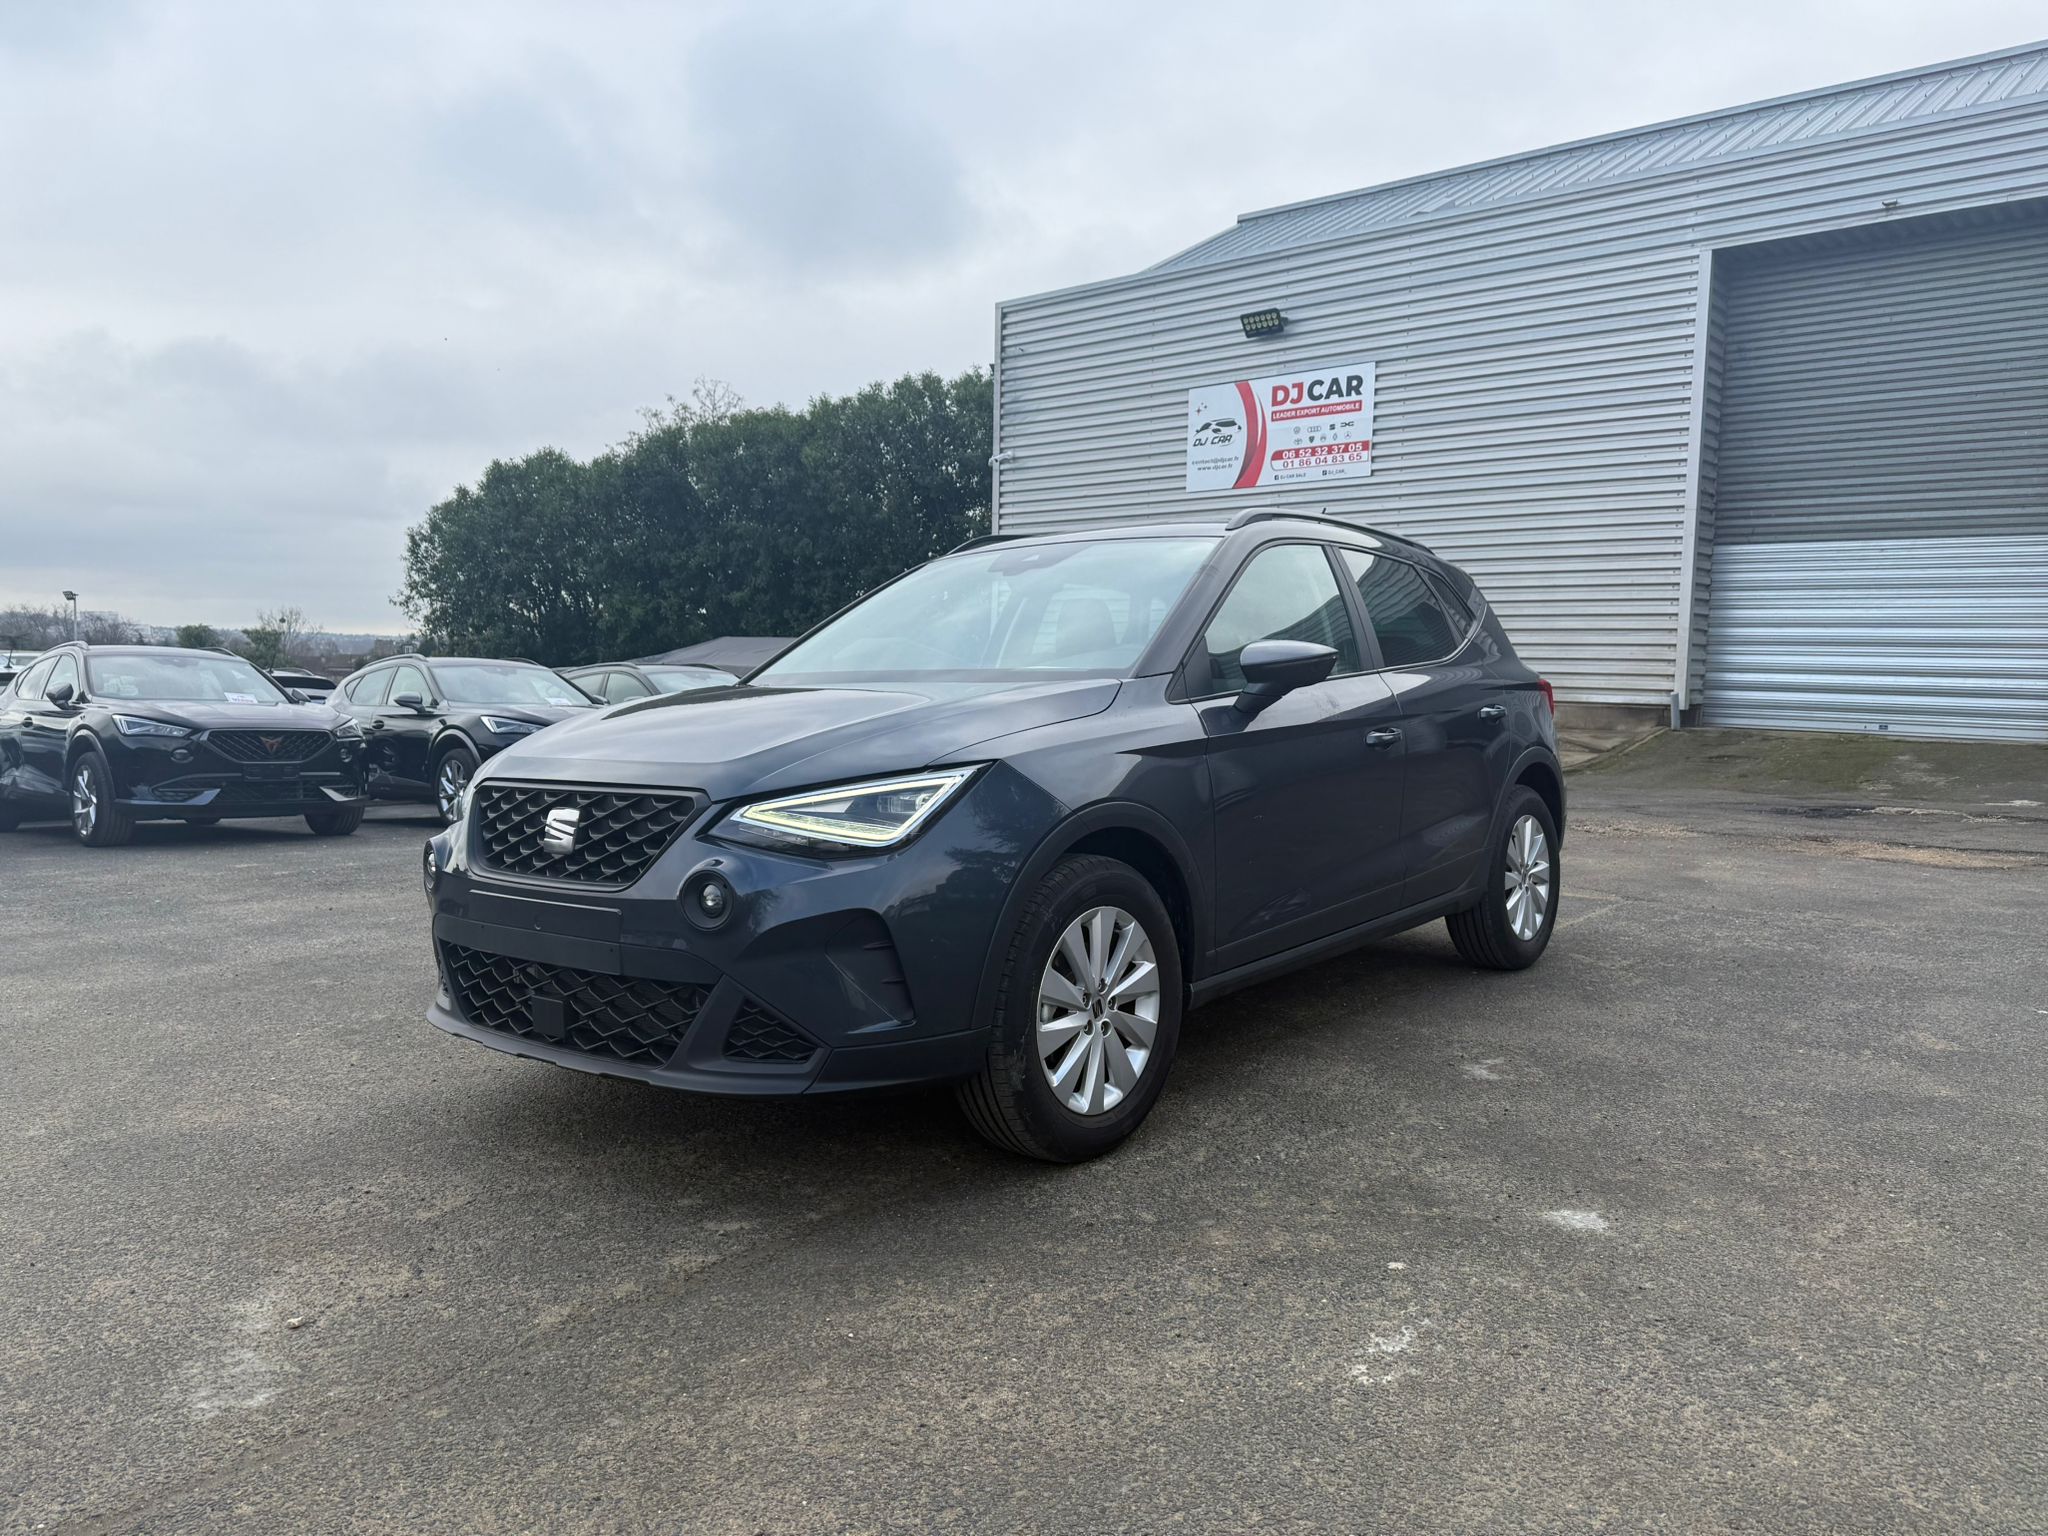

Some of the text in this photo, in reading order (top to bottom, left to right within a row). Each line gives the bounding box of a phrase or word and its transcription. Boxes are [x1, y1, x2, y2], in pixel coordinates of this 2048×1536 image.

[1272, 402, 1361, 420] LEADER EXPORT AUTOMOBILE
[1193, 434, 1233, 447] DJ CAR
[1282, 443, 1363, 459] 06 52 32 37 05
[1282, 453, 1362, 469] 01 86 04 83 65
